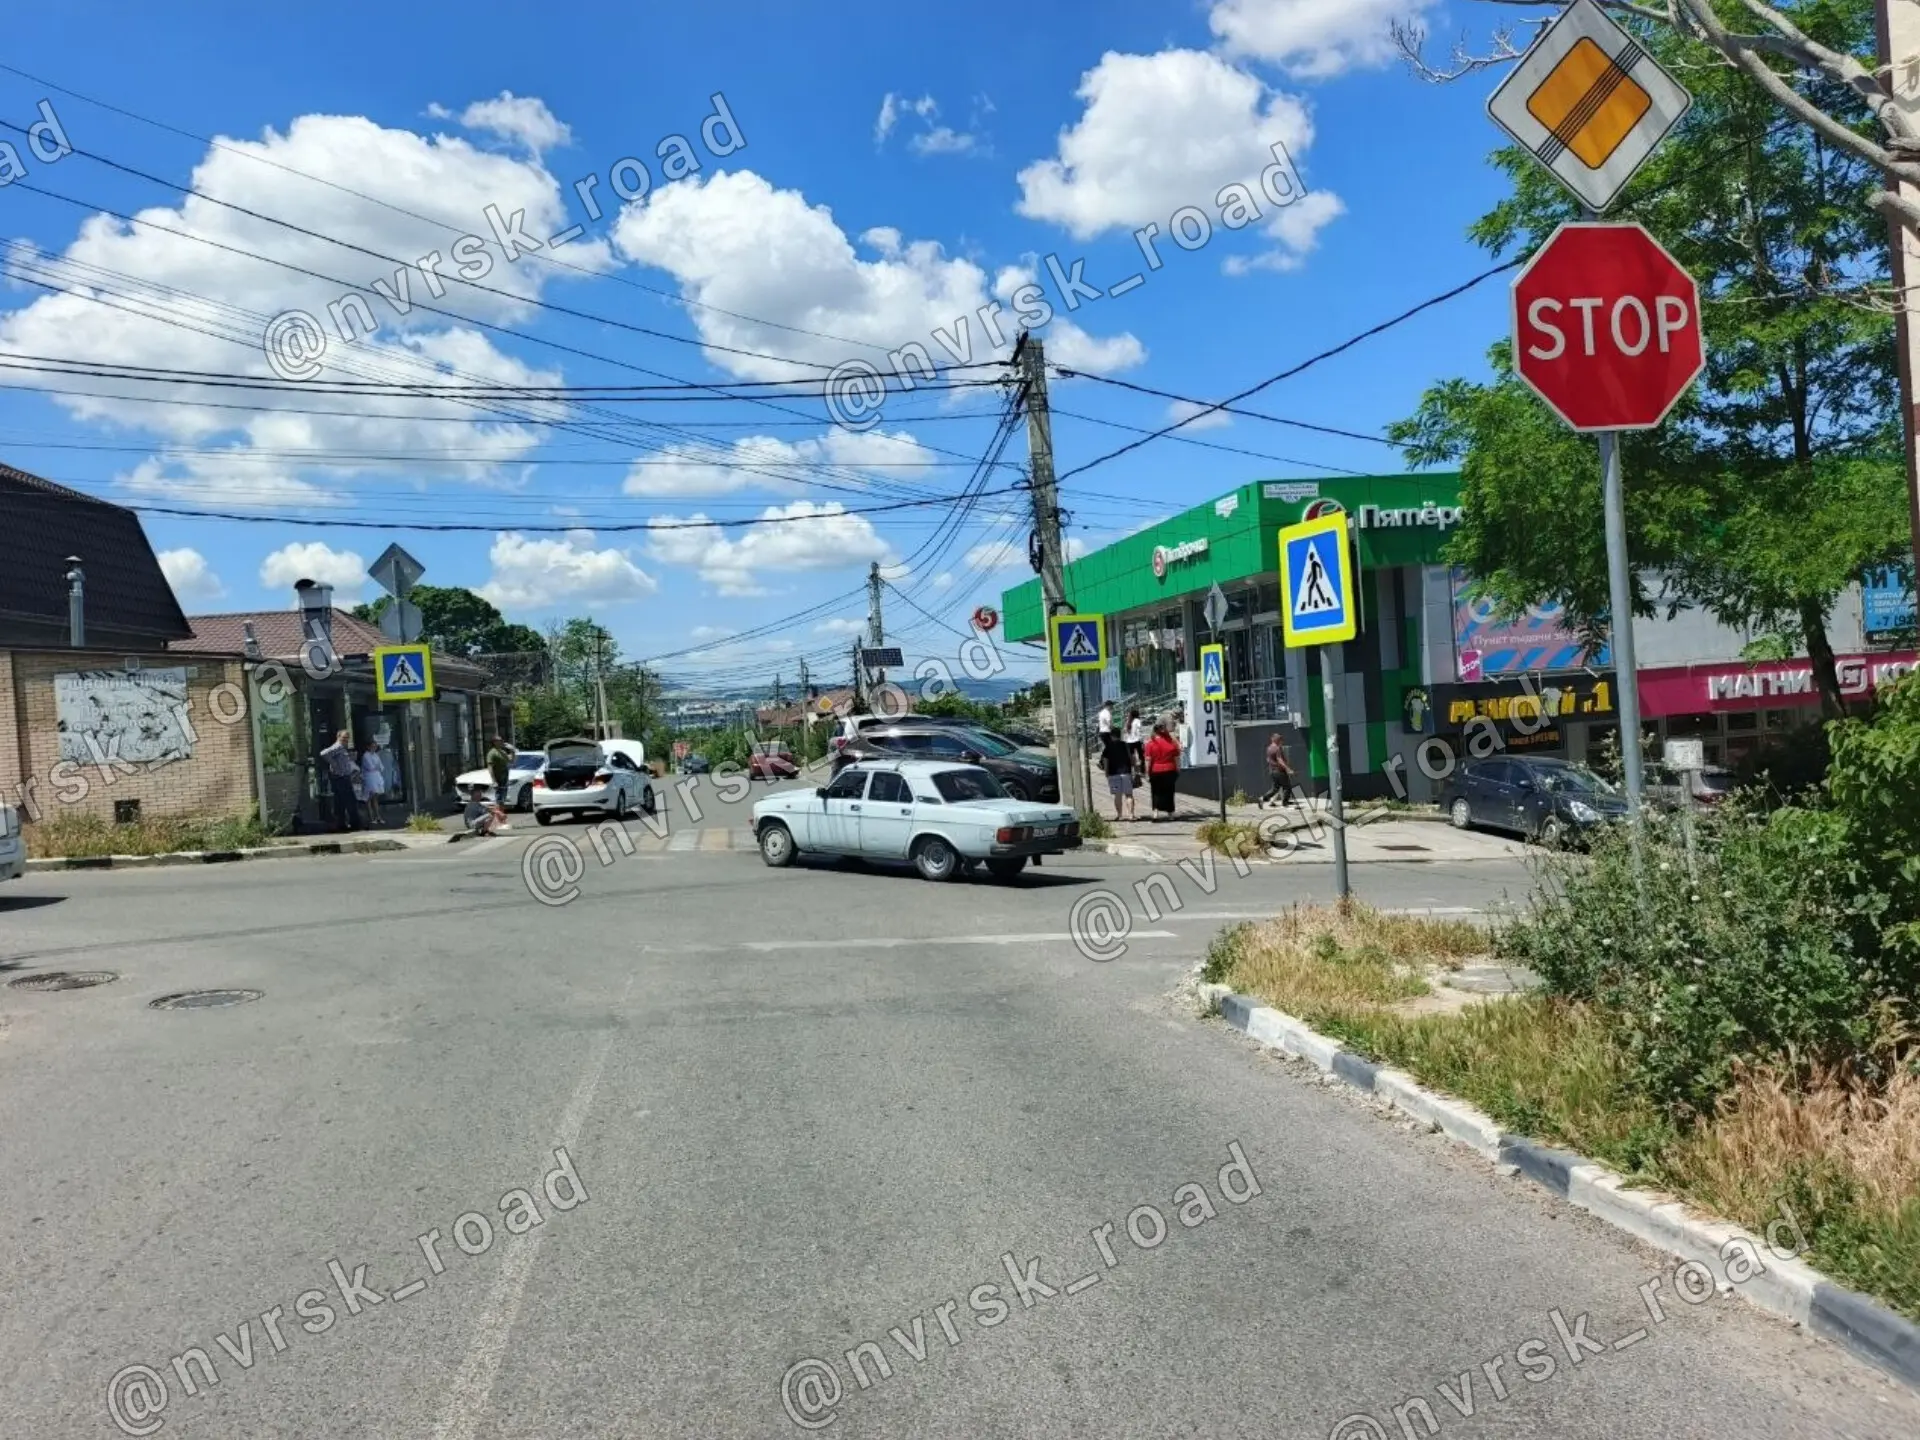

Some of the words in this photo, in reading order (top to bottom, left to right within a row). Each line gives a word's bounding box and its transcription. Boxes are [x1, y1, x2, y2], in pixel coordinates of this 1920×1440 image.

[1527, 295, 1689, 360] STOP
[1473, 633, 1508, 648] Пункт
[1708, 667, 1820, 700] МАГНИ
